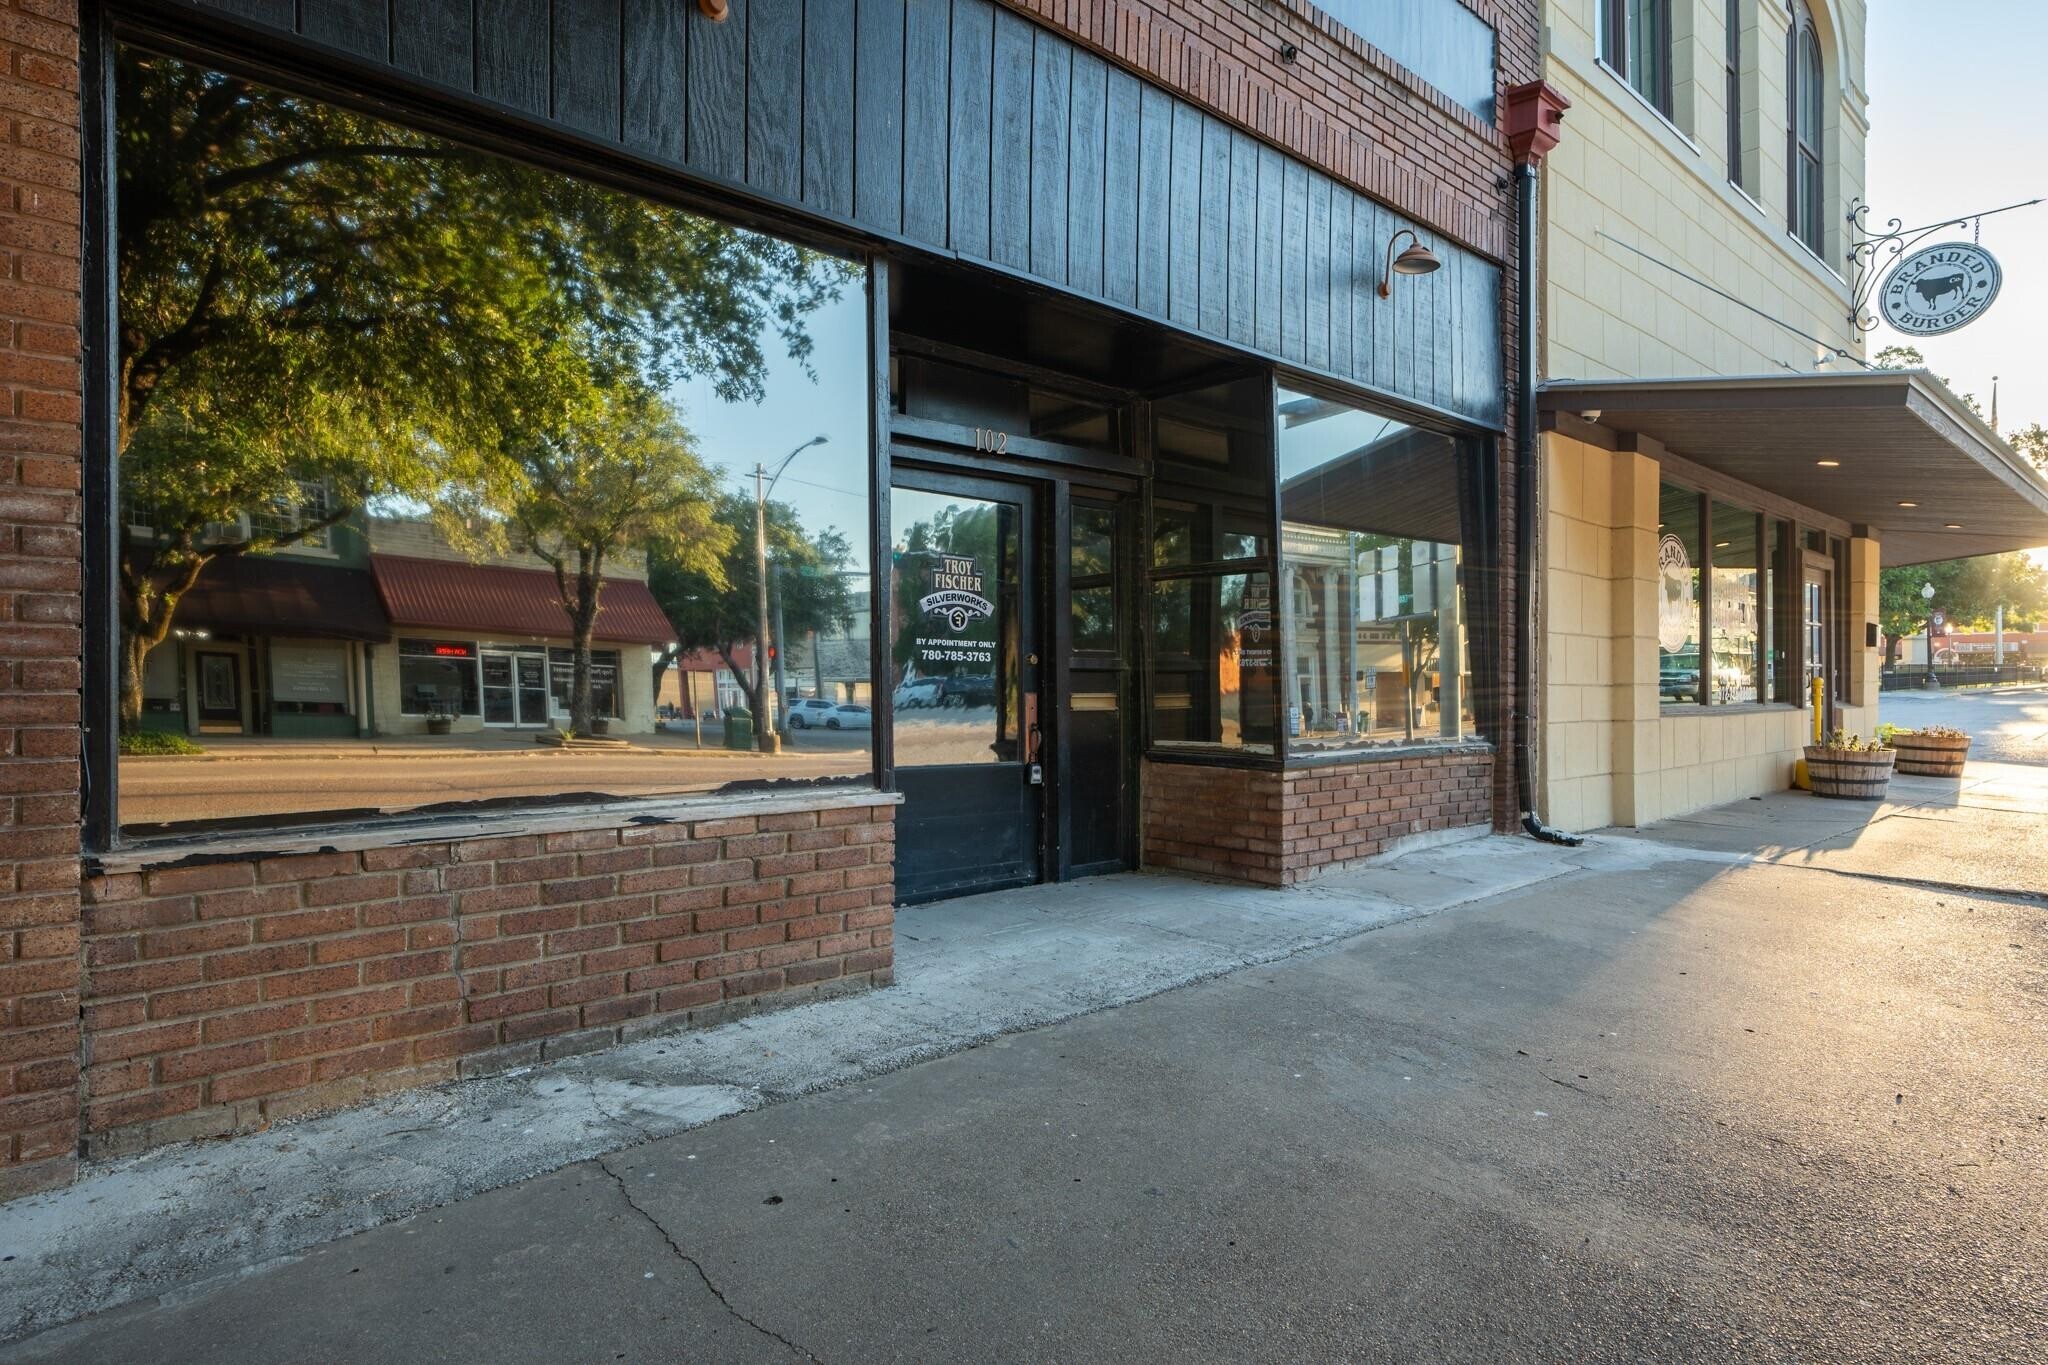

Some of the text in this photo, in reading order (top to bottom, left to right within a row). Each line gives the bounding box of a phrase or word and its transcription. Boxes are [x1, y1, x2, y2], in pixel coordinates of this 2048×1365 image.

[1890, 251, 1985, 295] BRANDED
[1899, 296, 1983, 329] BURGER
[975, 427, 1007, 455] 102
[944, 559, 973, 575] TROY
[935, 574, 982, 592] FISCHER
[926, 593, 988, 611] SILVERWORKS
[916, 637, 997, 649] BY APPOINTMENT ONLY
[921, 649, 992, 662] 780-785-3763
